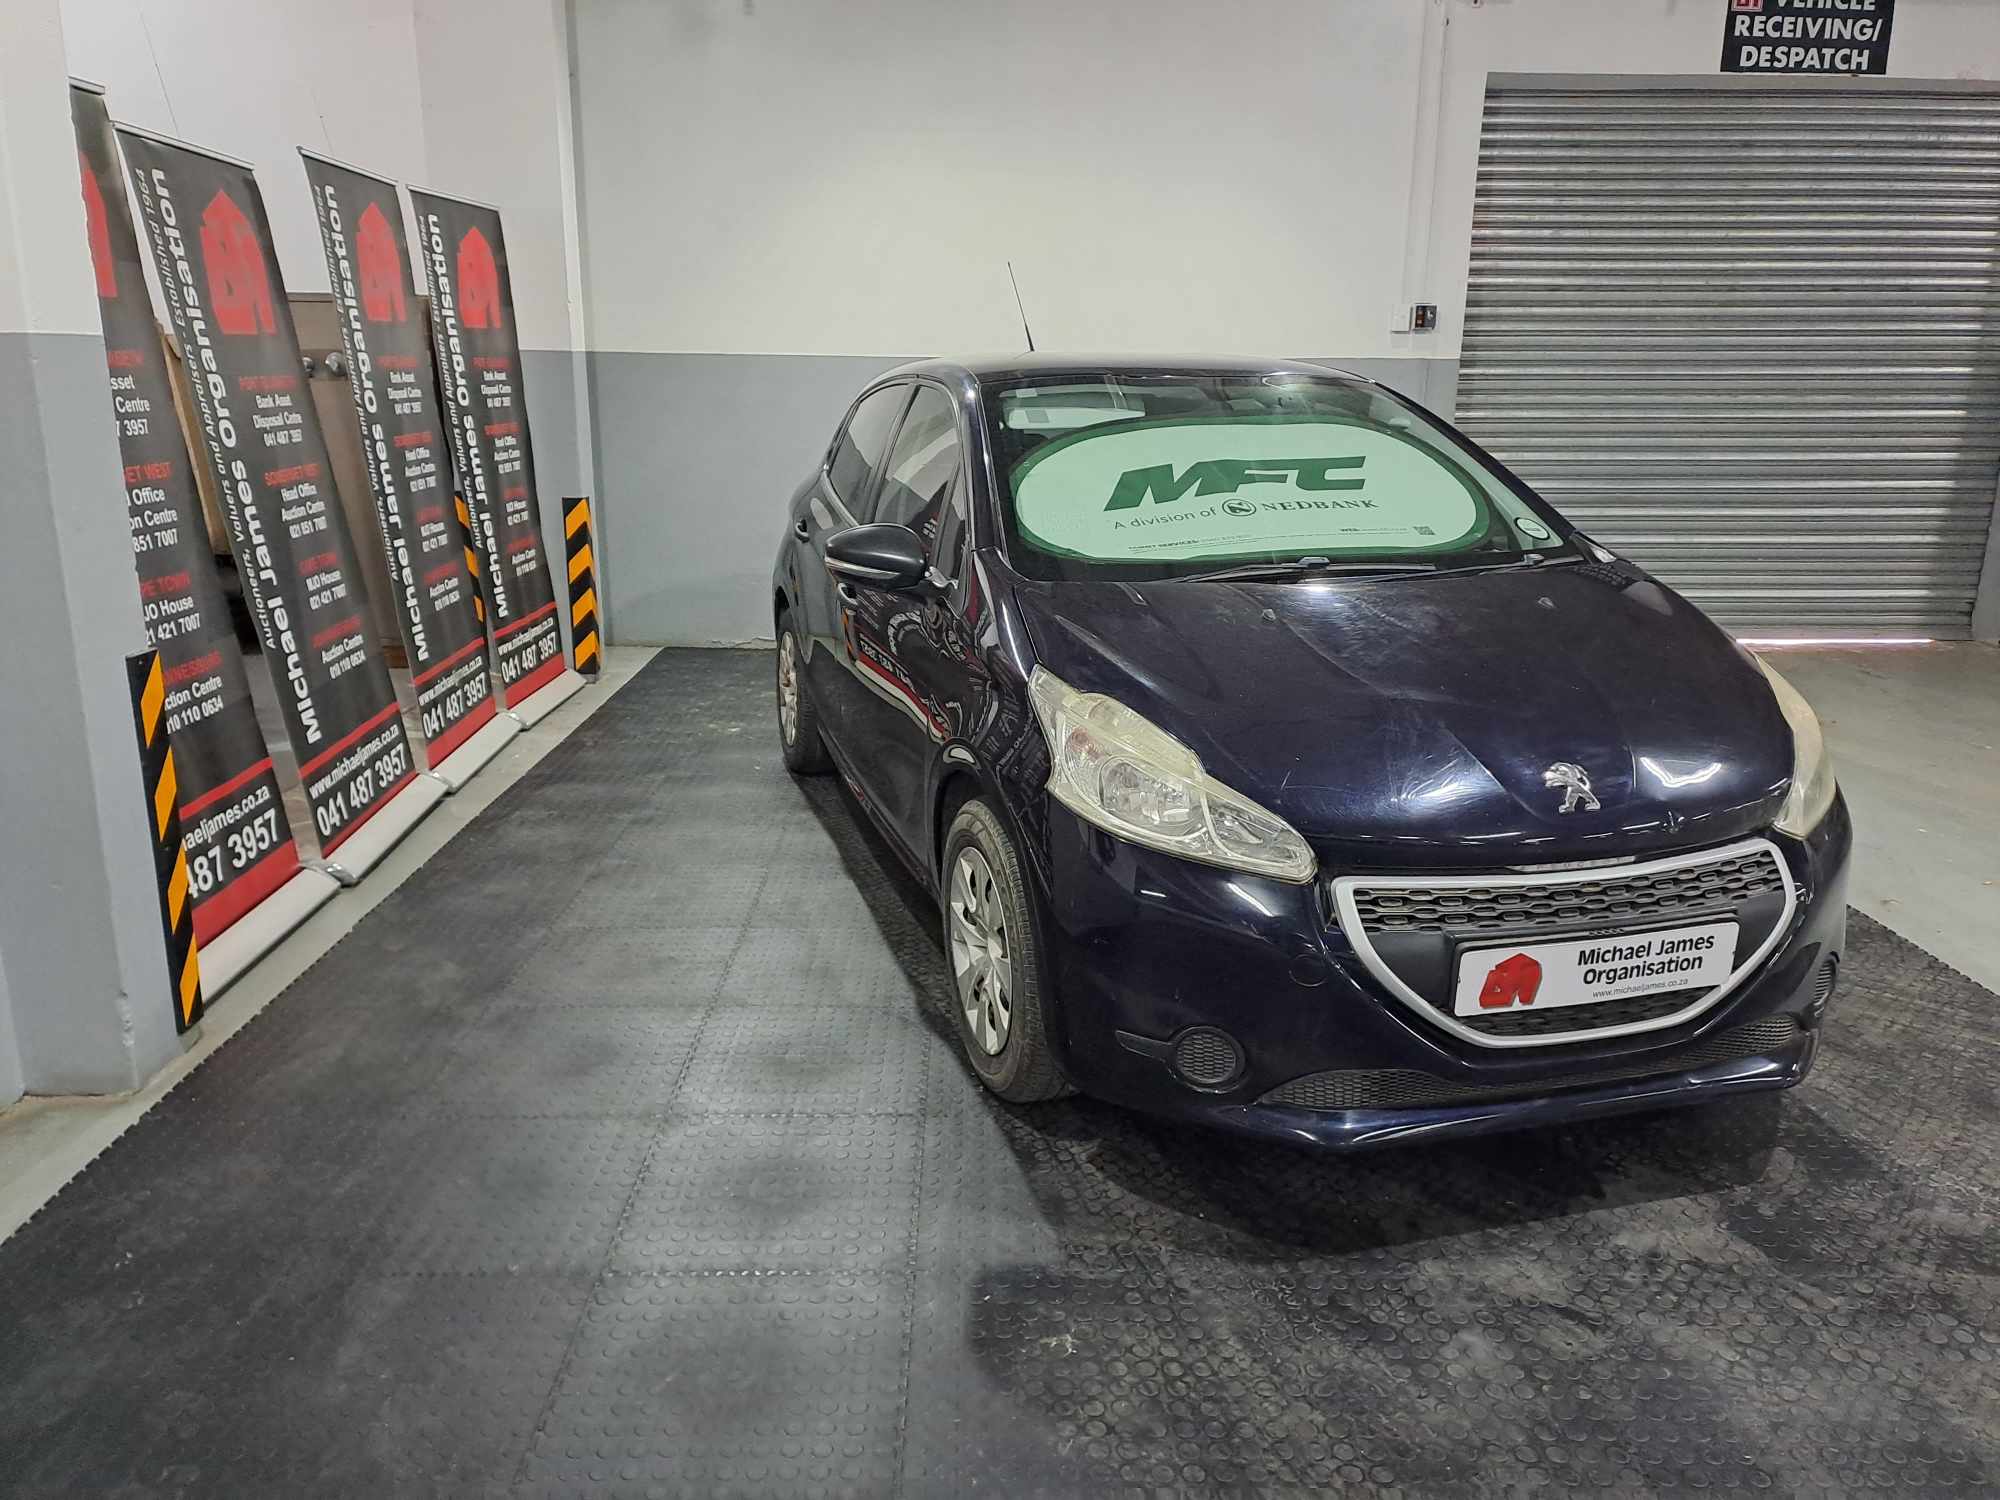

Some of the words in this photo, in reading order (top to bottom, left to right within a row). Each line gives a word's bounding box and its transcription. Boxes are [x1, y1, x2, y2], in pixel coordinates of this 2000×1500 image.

[1734, 14, 1883, 42] RECEIVING/
[1739, 45, 1870, 71] DESPATCH
[149, 220, 185, 326] Established
[151, 168, 237, 448] Organisation
[324, 185, 377, 414] Organisation
[427, 214, 470, 407] Organisation
[110, 374, 136, 390] sset
[184, 343, 215, 437] Appraisers
[115, 396, 150, 413] Centre
[123, 418, 149, 436] 3957
[210, 441, 226, 475] and
[371, 423, 402, 529] James
[463, 414, 488, 505] James
[132, 487, 165, 506] Office
[1103, 455, 1366, 512] MFC
[144, 508, 178, 527] Centre
[222, 479, 245, 542] Valuers
[231, 459, 278, 586] James
[1113, 519, 1127, 531] A
[1130, 510, 1196, 529] division
[1200, 506, 1217, 520] of
[1261, 499, 1380, 513] NEDBANK
[154, 528, 178, 549] 7007
[479, 512, 510, 619] Michael
[160, 596, 194, 617] House
[393, 537, 430, 662] Michael
[157, 621, 178, 640] 421
[178, 613, 201, 634] 7007
[267, 596, 322, 744] Michael
[501, 657, 520, 683] 041
[521, 644, 537, 671] 487
[538, 631, 556, 662] 3957
[191, 674, 223, 701] Centre
[422, 703, 445, 739] 041
[445, 690, 464, 722] 487
[464, 671, 488, 706] 3957
[180, 705, 201, 727] 110
[316, 791, 349, 836] 041
[350, 767, 375, 809] 487
[375, 743, 406, 788] 3957
[227, 807, 278, 869] 3957
[1578, 940, 1652, 967] Michael
[1656, 935, 1714, 956] James
[1583, 954, 1703, 986] Organisation
[1592, 978, 1688, 999] www.michaeljames.co.za
